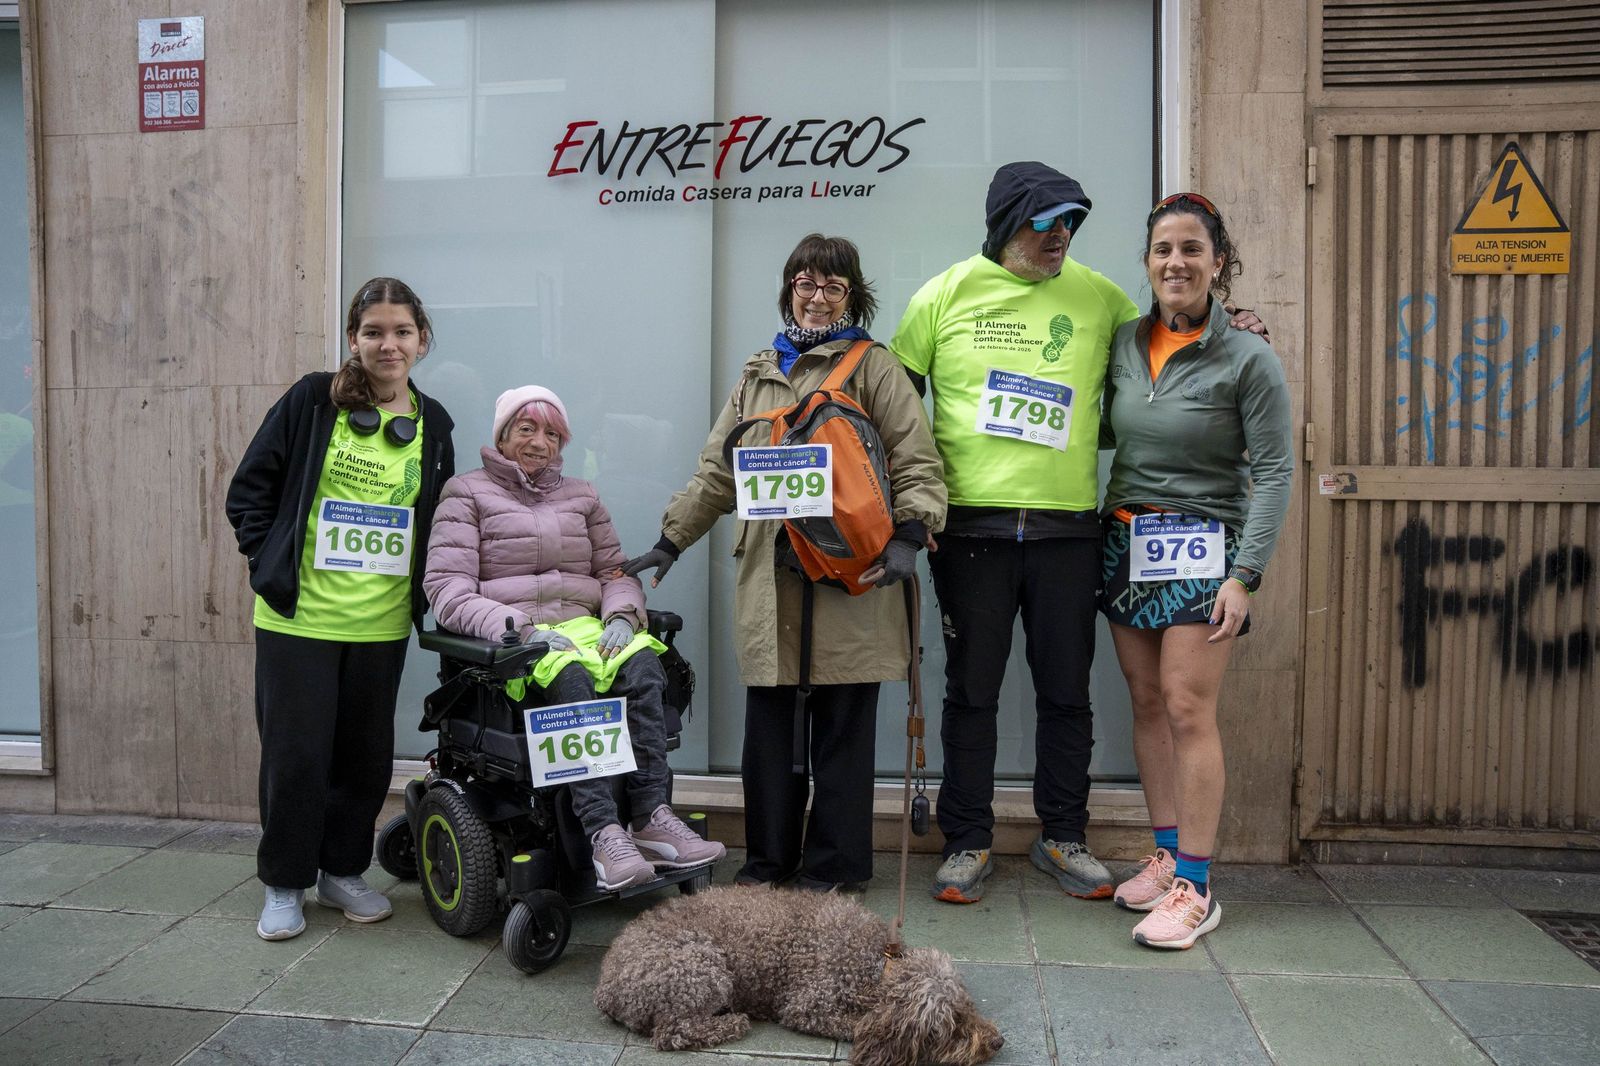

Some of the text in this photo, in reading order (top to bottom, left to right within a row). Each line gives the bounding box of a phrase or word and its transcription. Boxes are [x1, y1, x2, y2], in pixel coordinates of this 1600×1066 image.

[150, 36, 193, 58] Direct
[144, 65, 200, 82] Alarma
[156, 82, 173, 90] aviso
[599, 180, 876, 206] Comida Casera para Llevar
[1476, 240, 1546, 250] ALTA TENSION
[1457, 253, 1564, 262] PELIGRO DE MUERTE
[976, 320, 1027, 330] II Almería
[1004, 336, 1012, 344] el
[1014, 337, 1044, 346] cáncer
[996, 382, 1020, 390] contra
[1030, 388, 1055, 399] cáncer
[1040, 383, 1066, 394] marcha
[988, 394, 1066, 431] 1798
[336, 450, 344, 459] II
[744, 452, 750, 460] II
[791, 450, 818, 458] marcha
[333, 460, 378, 478] en marcha
[748, 460, 772, 468] contra
[783, 458, 808, 467] cáncer
[330, 468, 396, 489] contra el cáncer
[341, 481, 362, 492] febrero
[744, 472, 826, 500] 1799
[331, 512, 355, 521] contra
[364, 516, 389, 525] cáncer
[374, 508, 400, 518] marcha
[1175, 524, 1200, 532] cáncer
[325, 526, 405, 556] 1666
[1146, 536, 1208, 562] 976
[586, 704, 614, 714] marcha
[541, 720, 568, 730] contra
[579, 714, 604, 724] cáncer
[538, 728, 622, 764] 1667
